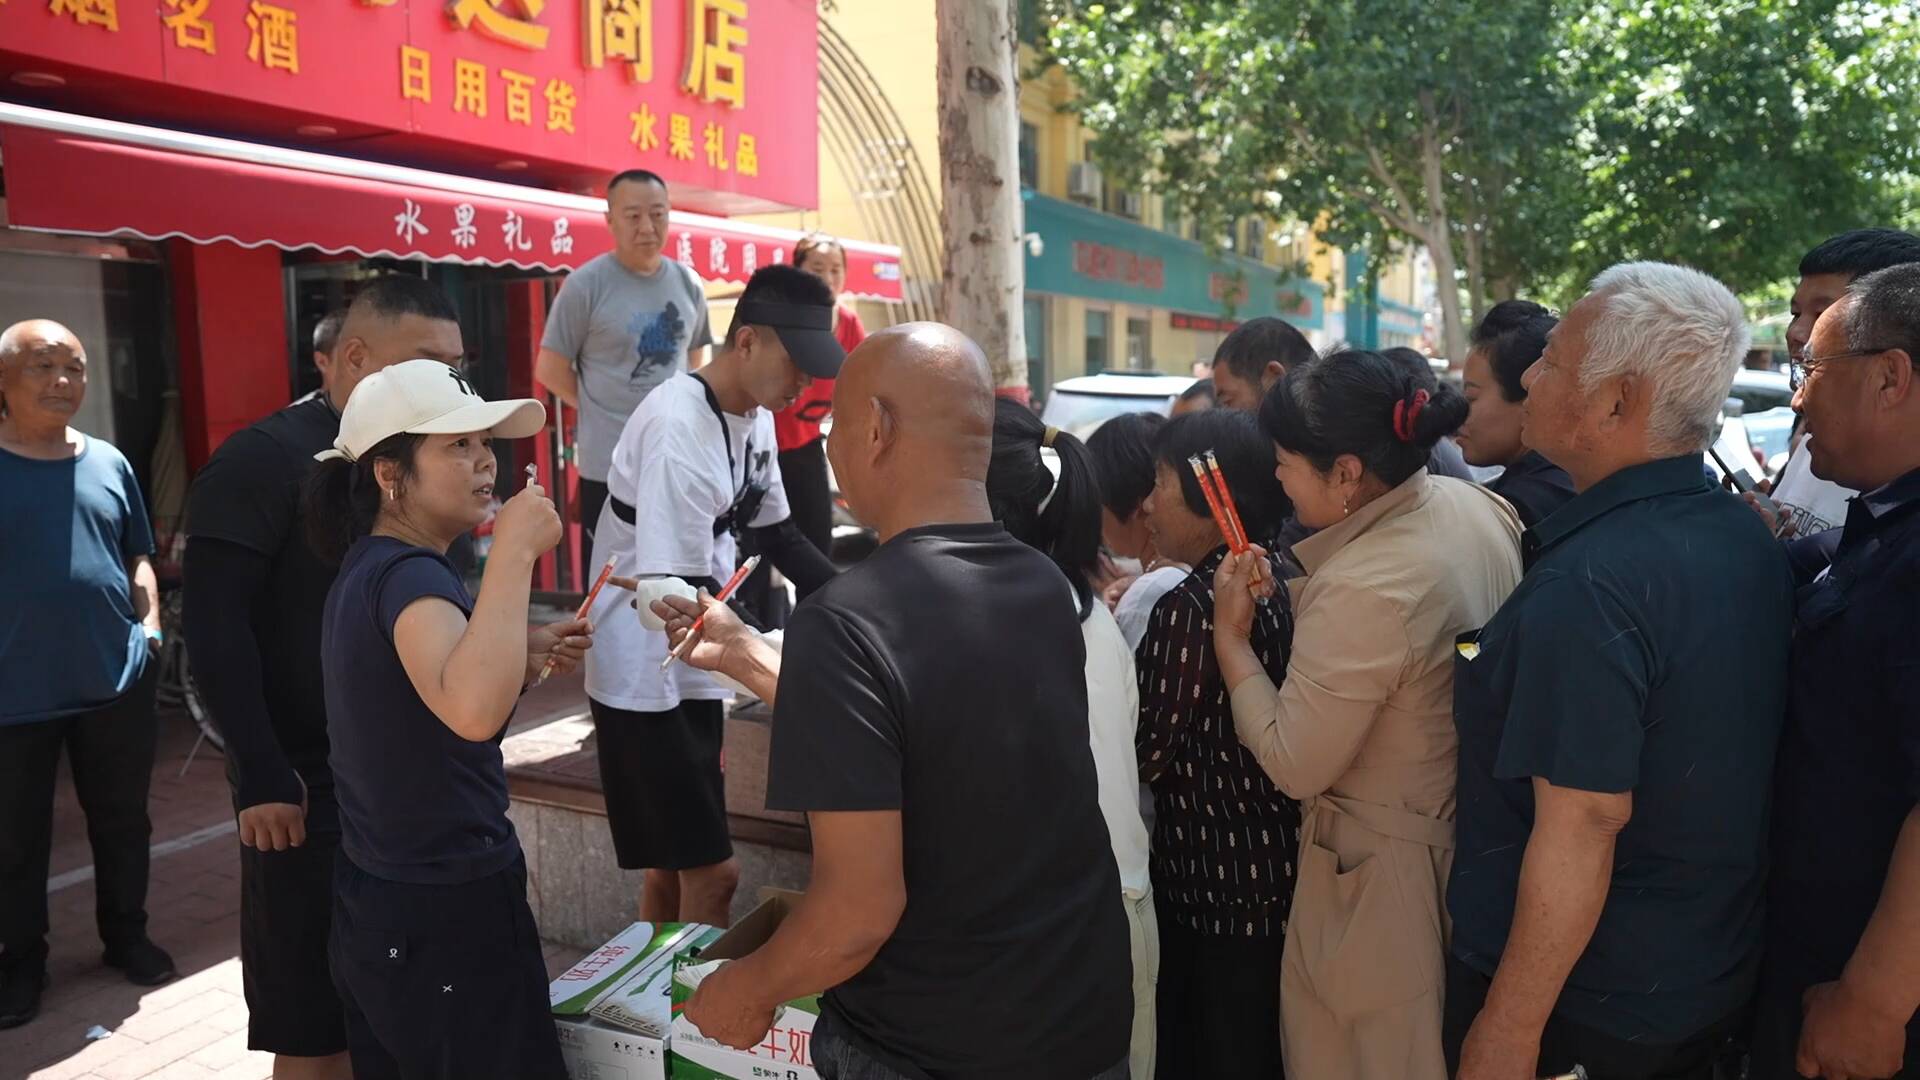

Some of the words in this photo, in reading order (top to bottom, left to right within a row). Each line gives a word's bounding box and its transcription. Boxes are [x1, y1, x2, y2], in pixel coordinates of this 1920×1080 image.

[400, 44, 577, 134] 日用百货
[629, 103, 759, 177] 水果礼品
[394, 198, 575, 256] 水果礼品
